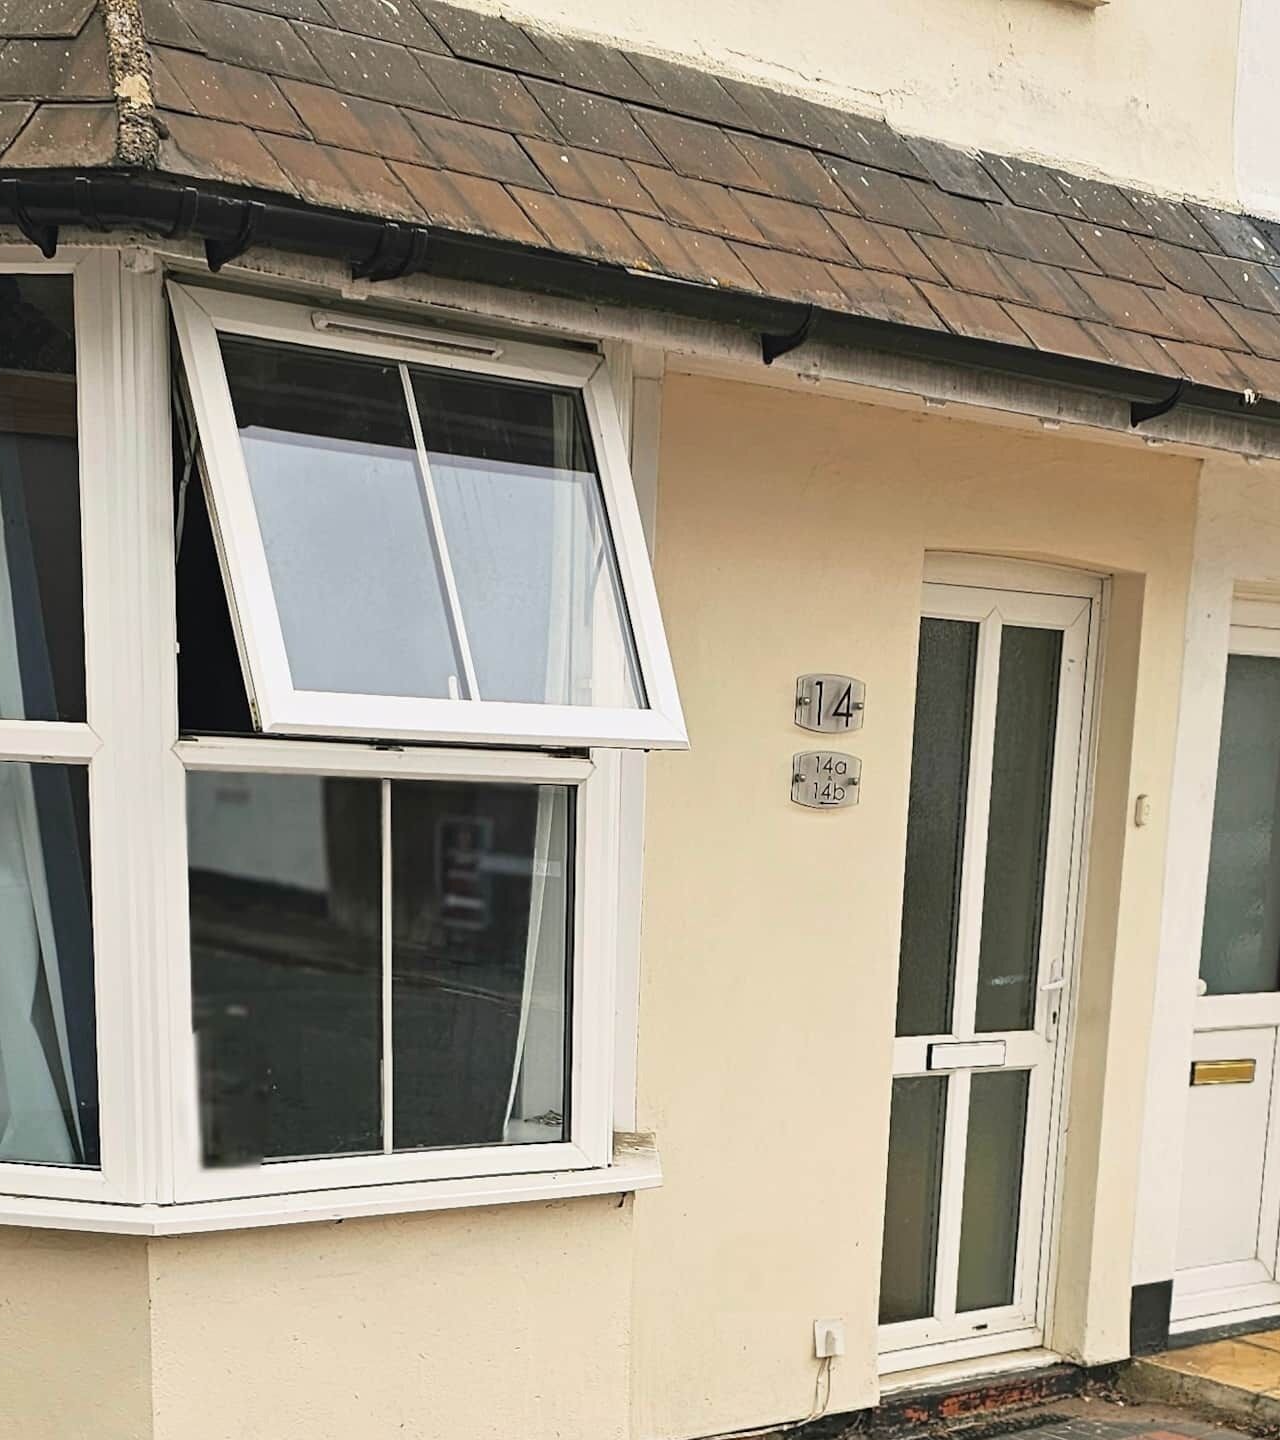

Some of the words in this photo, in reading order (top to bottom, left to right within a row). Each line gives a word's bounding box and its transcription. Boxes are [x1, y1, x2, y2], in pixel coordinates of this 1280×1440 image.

[815, 680, 853, 728] 14
[816, 756, 847, 775] 14a
[813, 782, 845, 801] 14b
